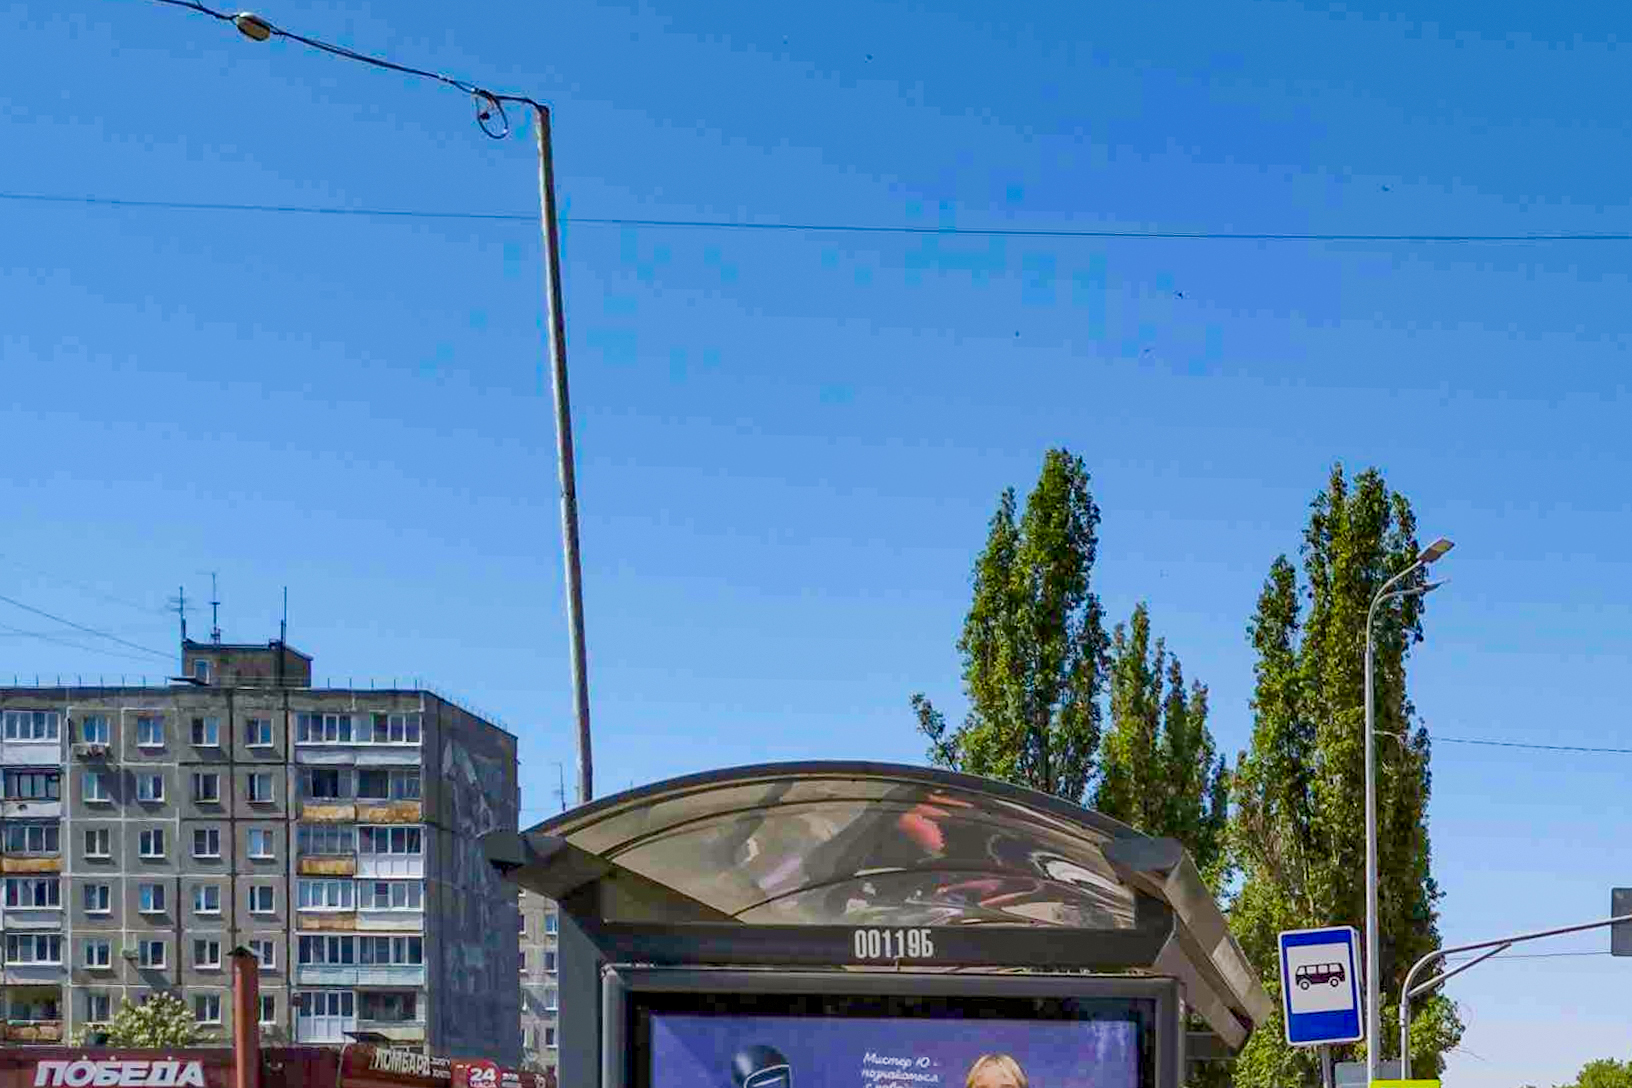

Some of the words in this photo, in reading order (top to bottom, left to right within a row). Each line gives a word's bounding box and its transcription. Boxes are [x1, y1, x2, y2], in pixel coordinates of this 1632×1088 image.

[369, 1047, 430, 1076] ЛОМБАРД
[863, 1051, 912, 1071] Мистер
[34, 1060, 205, 1088] ПОБЕДА
[470, 1067, 497, 1081] 24
